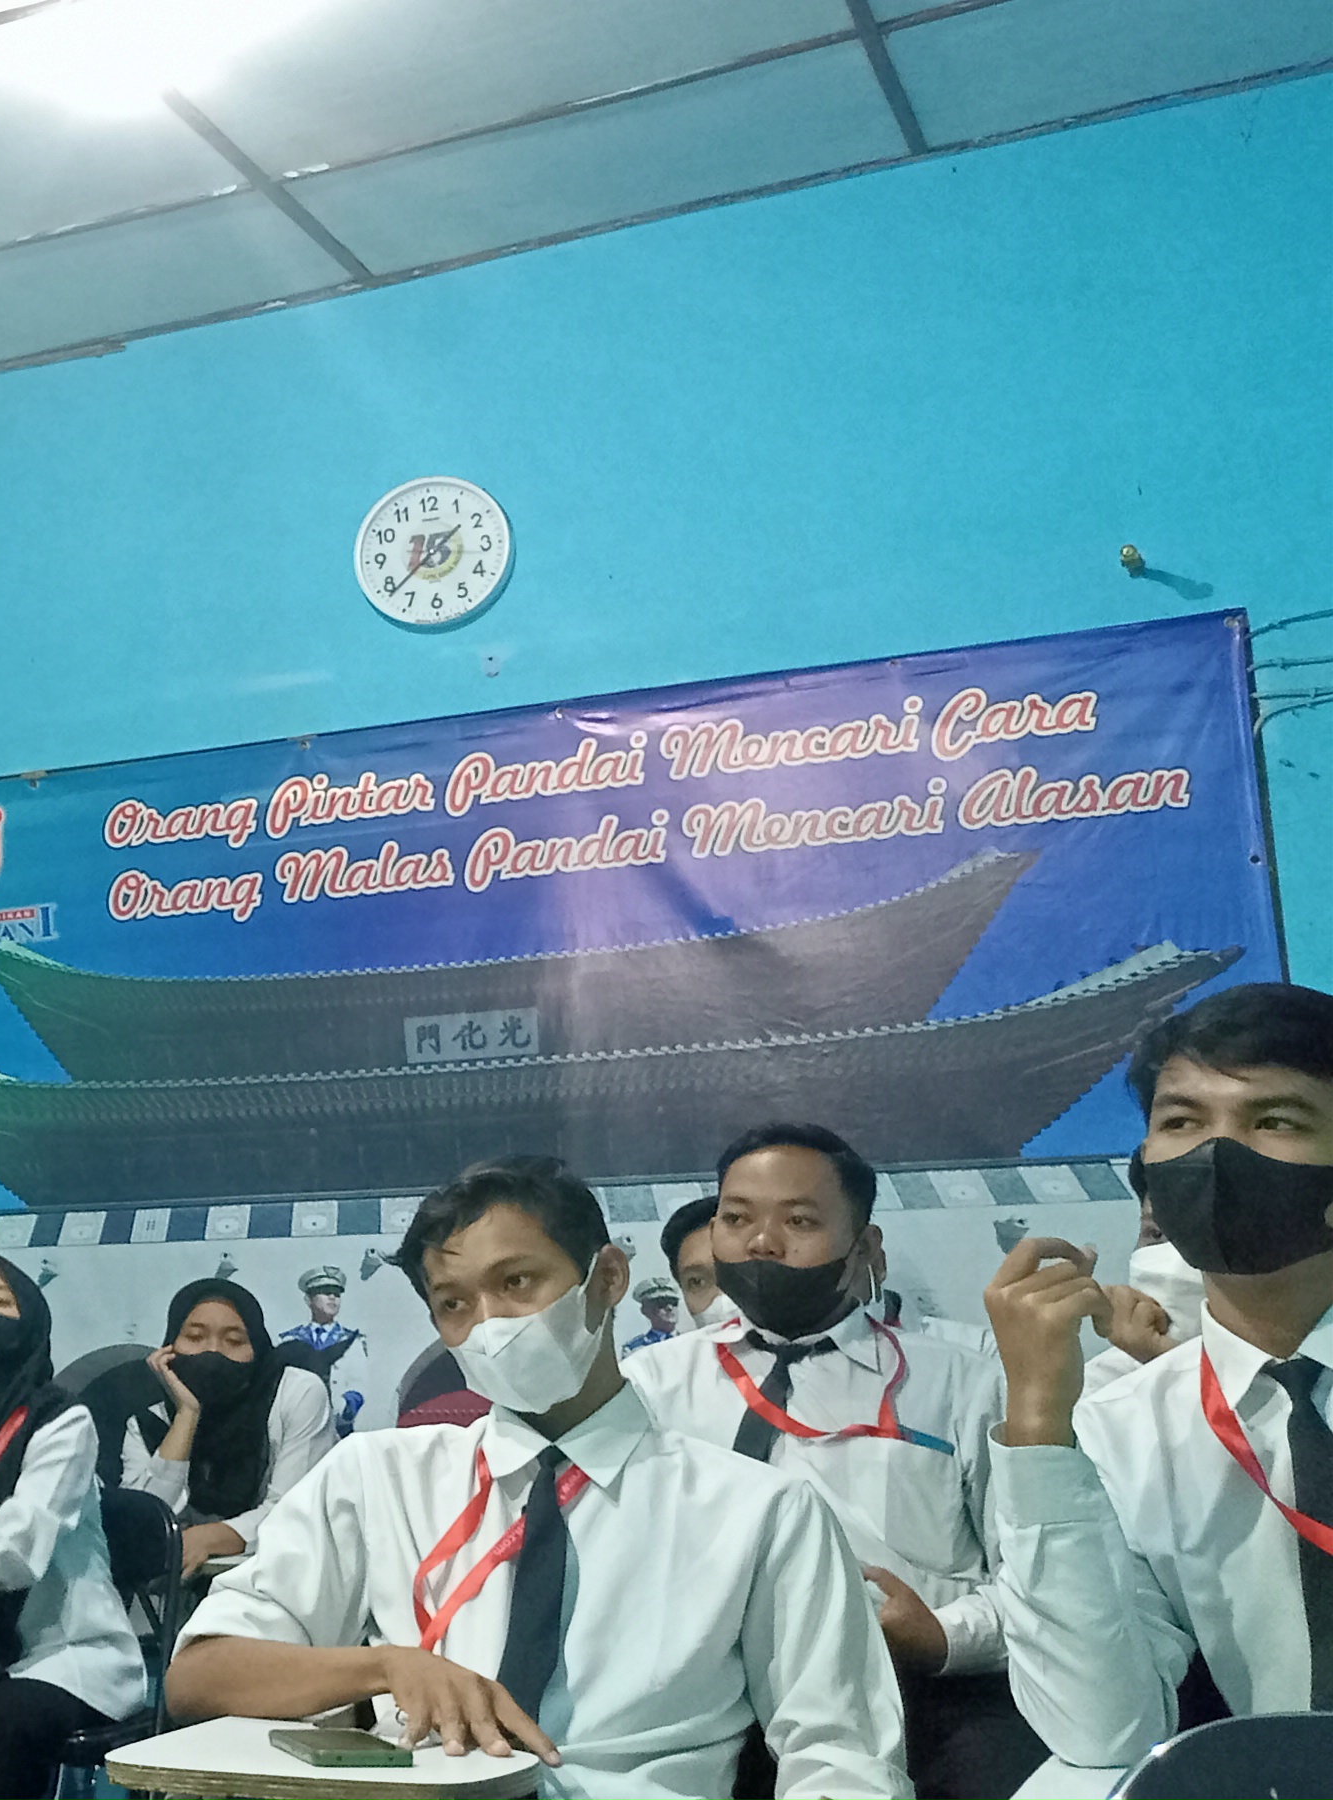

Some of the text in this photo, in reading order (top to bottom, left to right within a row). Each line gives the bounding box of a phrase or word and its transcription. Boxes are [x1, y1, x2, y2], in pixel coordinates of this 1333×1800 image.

[419, 496, 438, 513] 12
[452, 499, 460, 514] 1
[394, 507, 409, 523] 11
[470, 512, 483, 529] 2
[375, 528, 395, 545] 10
[479, 534, 492, 552] 3
[374, 552, 387, 570] 9
[472, 560, 486, 577] 4
[383, 576, 395, 592] 8
[457, 582, 469, 599] 5
[404, 591, 416, 608] 7
[430, 592, 443, 609] 6
[103, 686, 1097, 850] Orang Pintar Pandai Mencari Cara
[107, 766, 1191, 923] Orang Malas Pandai Mencari Alasan
